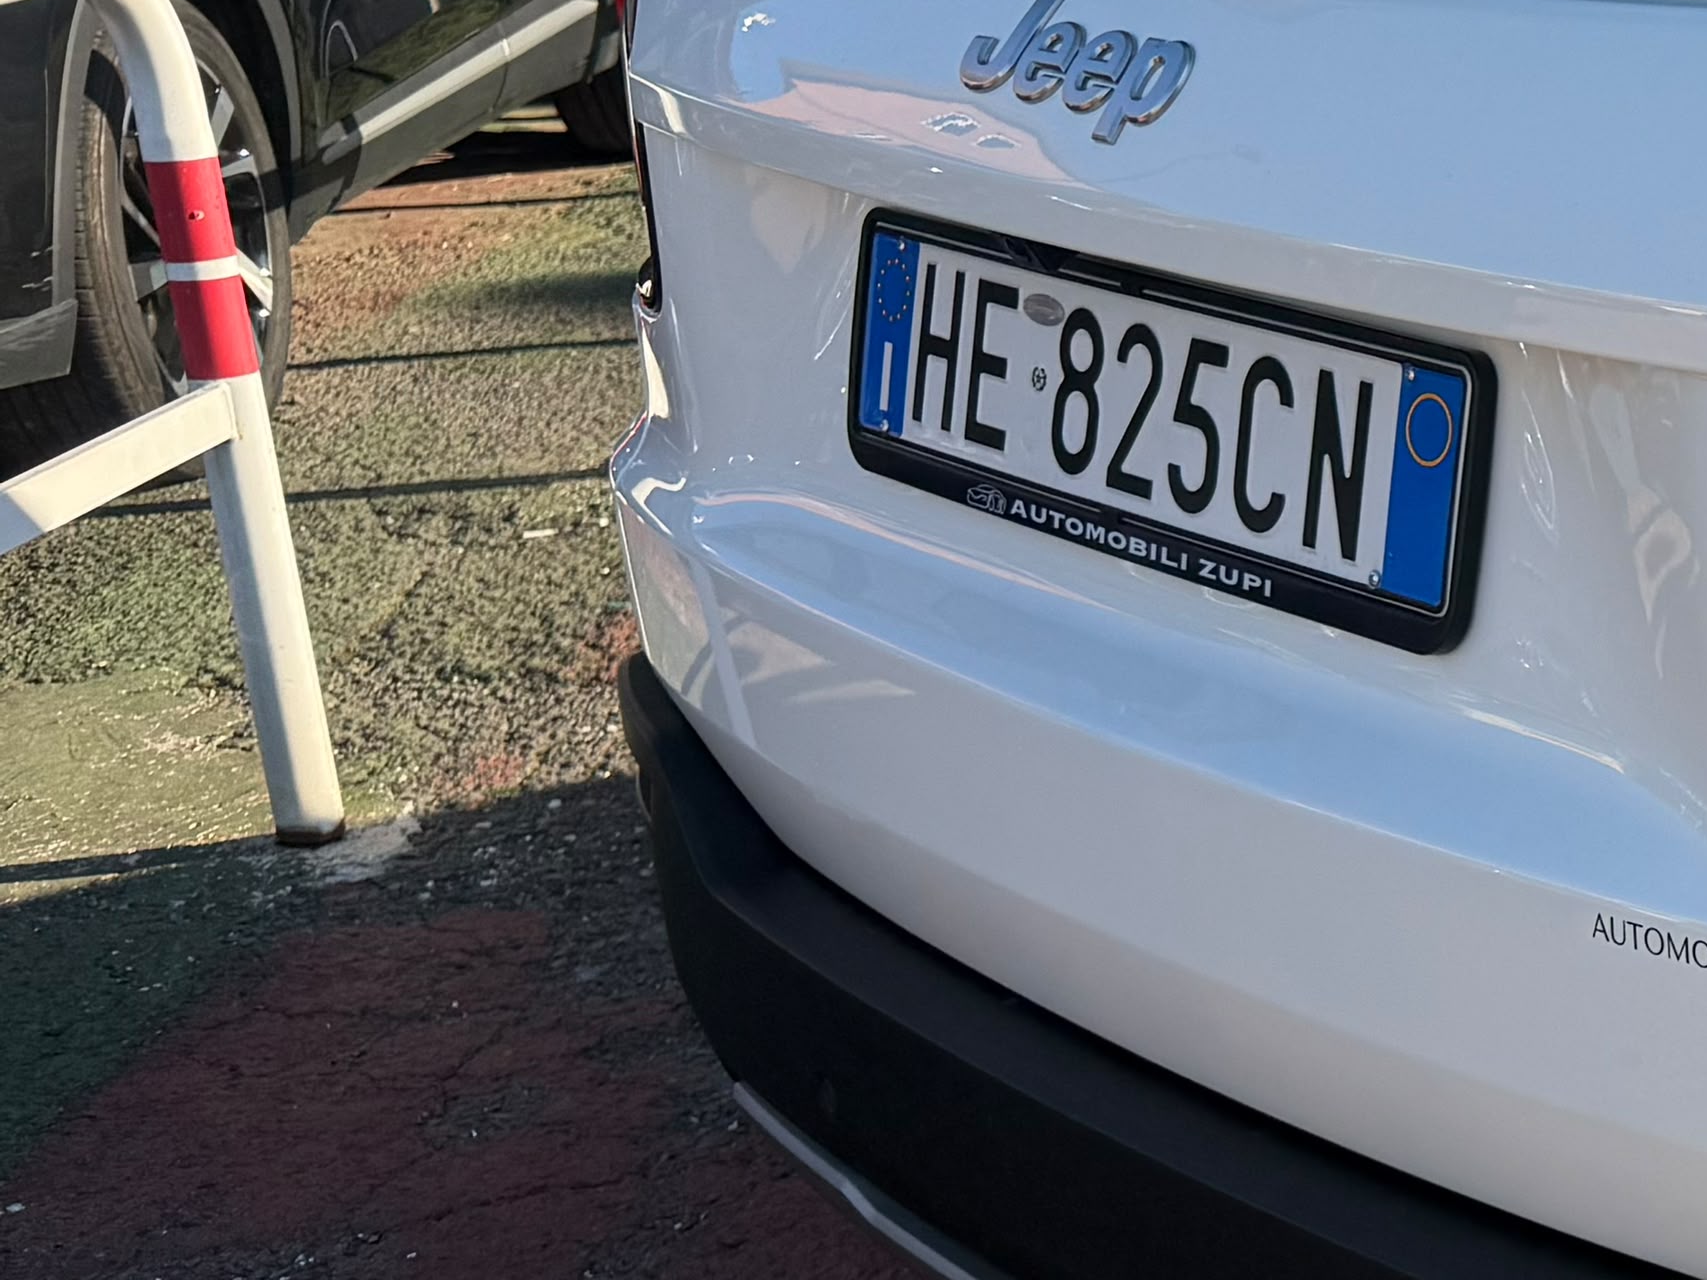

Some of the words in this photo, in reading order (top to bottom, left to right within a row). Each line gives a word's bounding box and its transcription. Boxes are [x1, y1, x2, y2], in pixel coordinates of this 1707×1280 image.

[912, 262, 1019, 452] HE
[1051, 307, 1374, 562] 825CN
[1010, 498, 1189, 571] AUTOMOBILI
[1198, 557, 1273, 598] ZUPI
